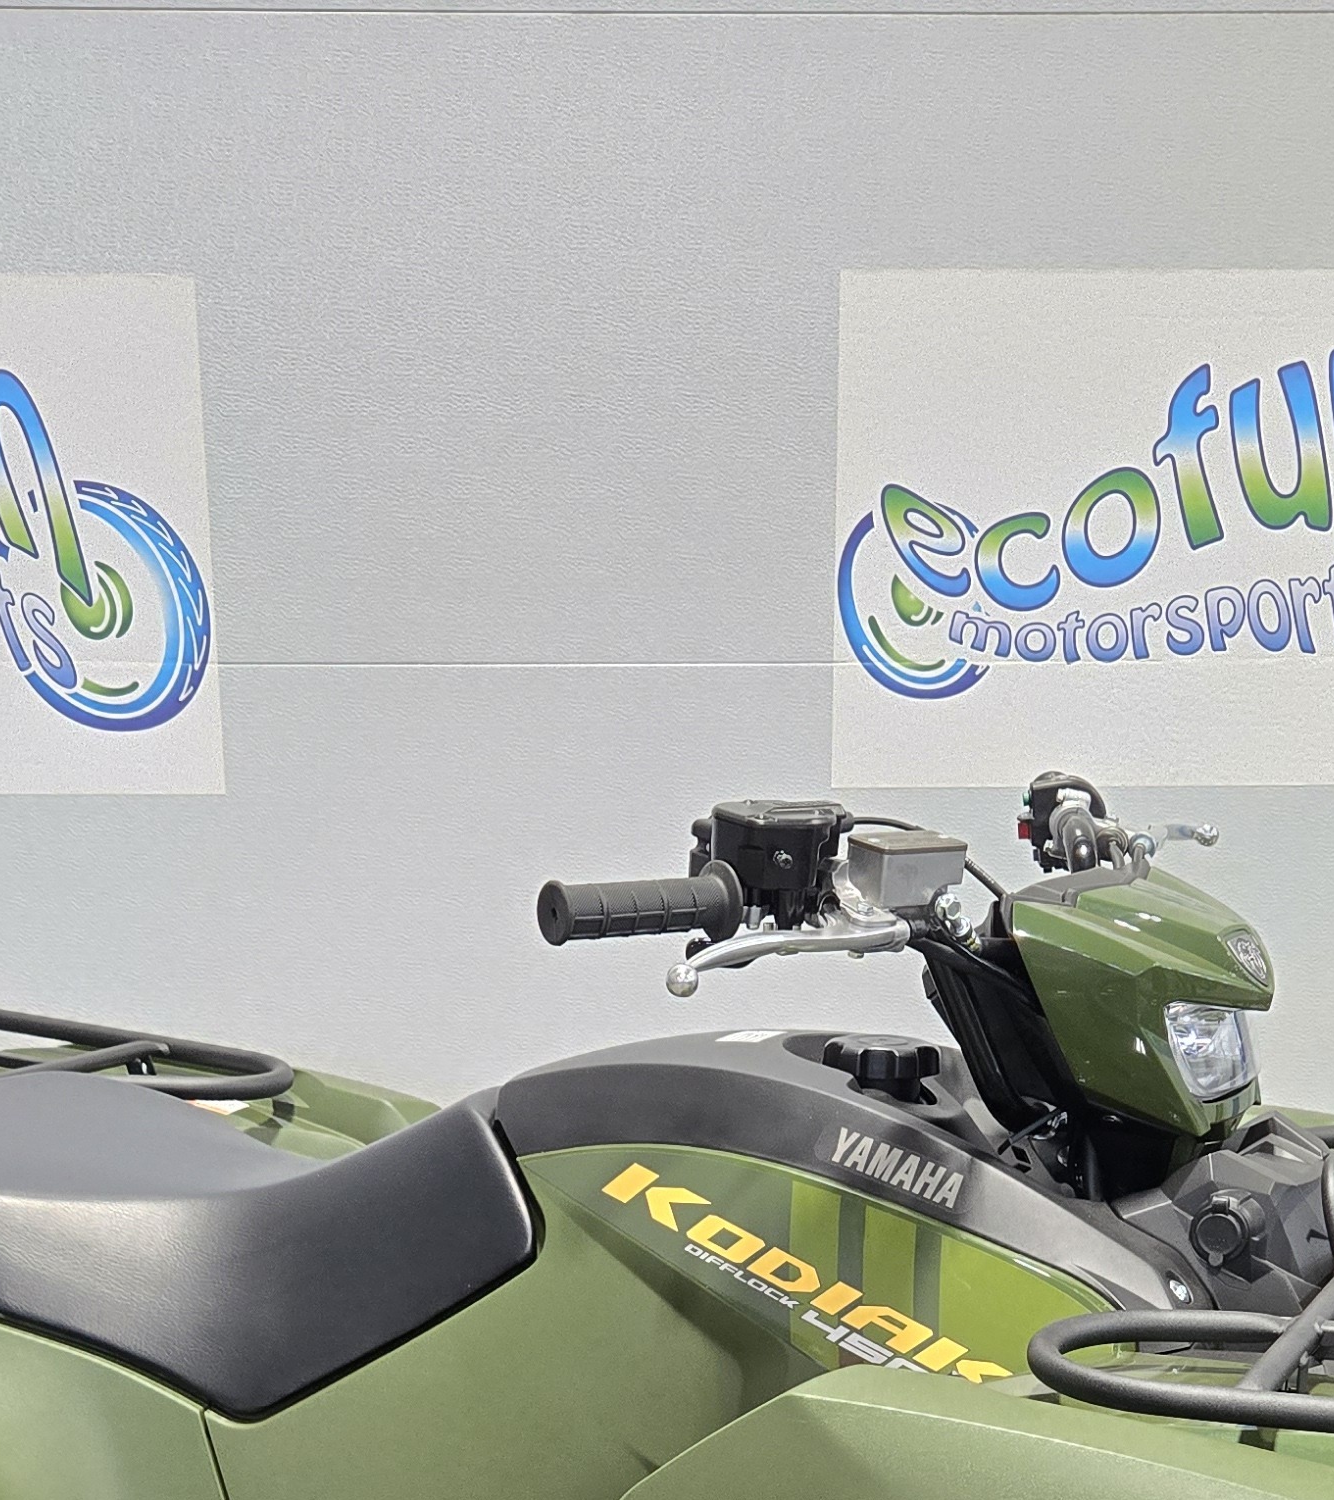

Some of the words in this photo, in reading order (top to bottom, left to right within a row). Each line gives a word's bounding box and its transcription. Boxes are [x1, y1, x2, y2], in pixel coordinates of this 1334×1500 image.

[830, 1126, 965, 1210] YAMAHA
[602, 1162, 1015, 1384] KODIAK
[684, 1243, 800, 1310] DIFFLOCK
